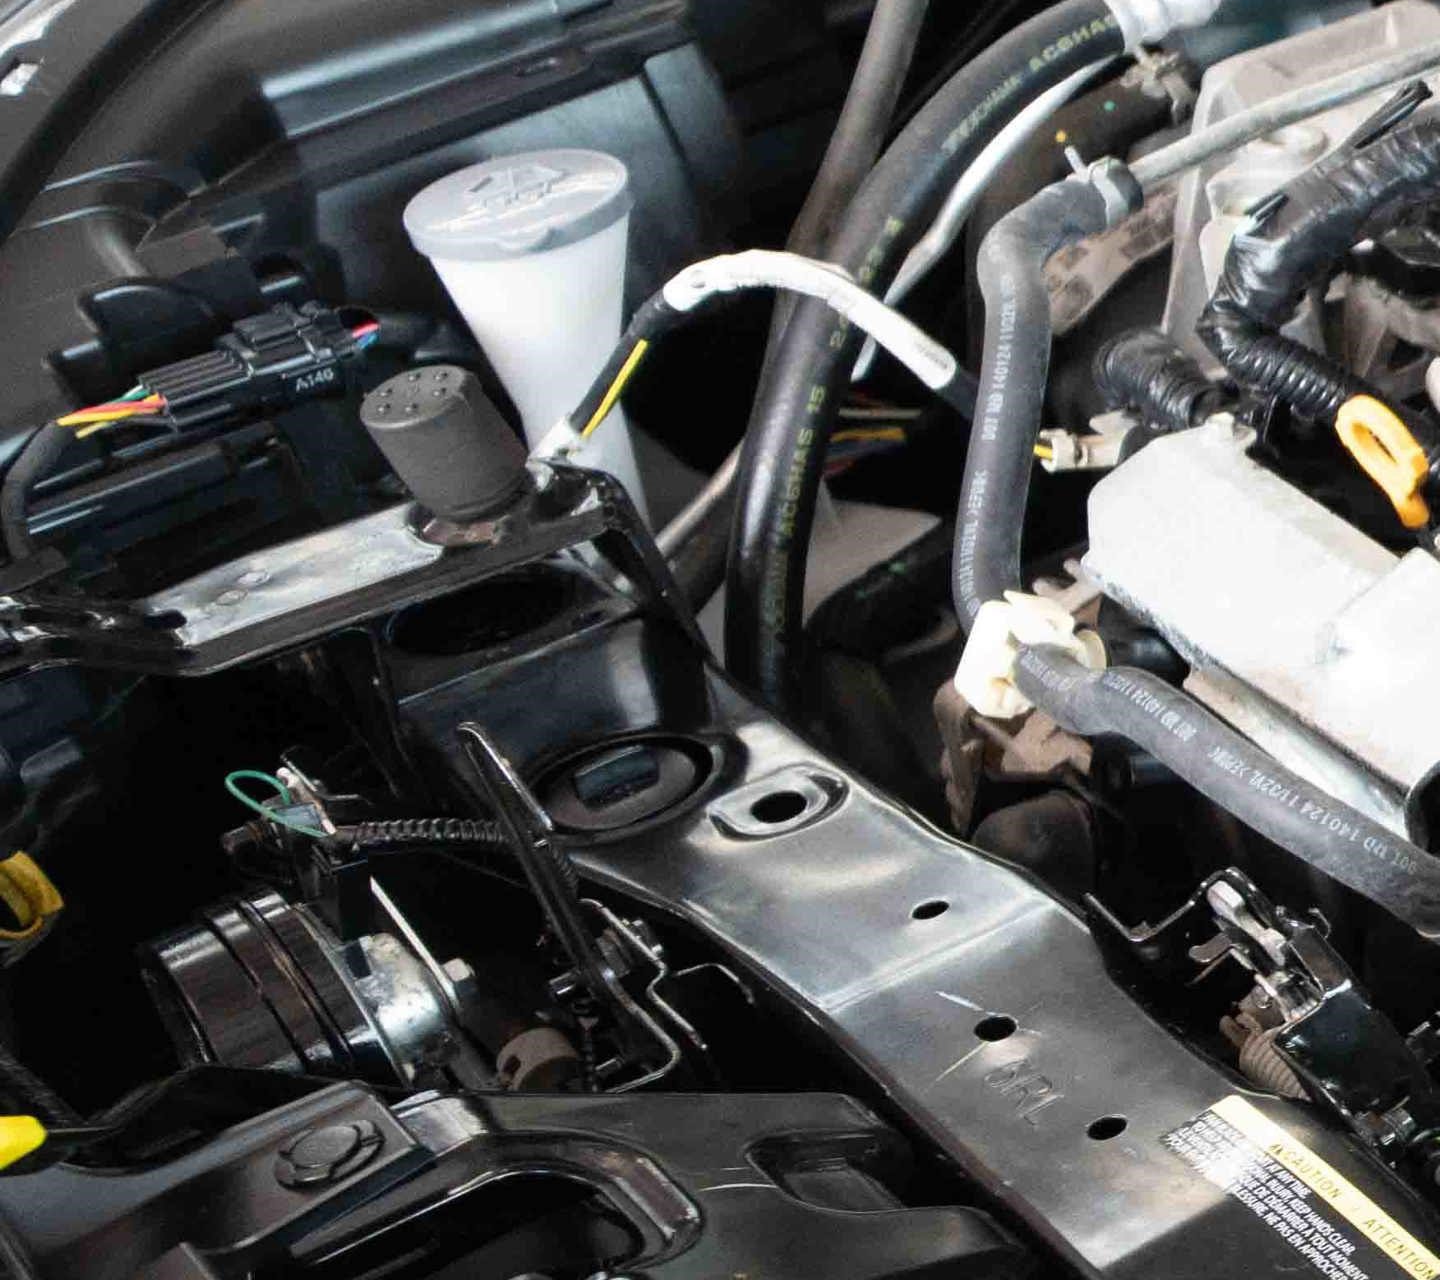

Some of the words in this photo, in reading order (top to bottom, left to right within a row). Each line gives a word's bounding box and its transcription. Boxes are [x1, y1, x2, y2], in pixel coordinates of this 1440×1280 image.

[1252, 1185, 1271, 1199] DE
[1305, 1232, 1336, 1255] TOUT
[1261, 1210, 1282, 1226] NE
[1277, 1146, 1343, 1199] CAUTION
[1359, 1216, 1440, 1280] ATTENTION
[1301, 1210, 1337, 1237] HANDS
[1271, 1219, 1296, 1238] PAS
[1285, 1231, 1307, 1248] EN
